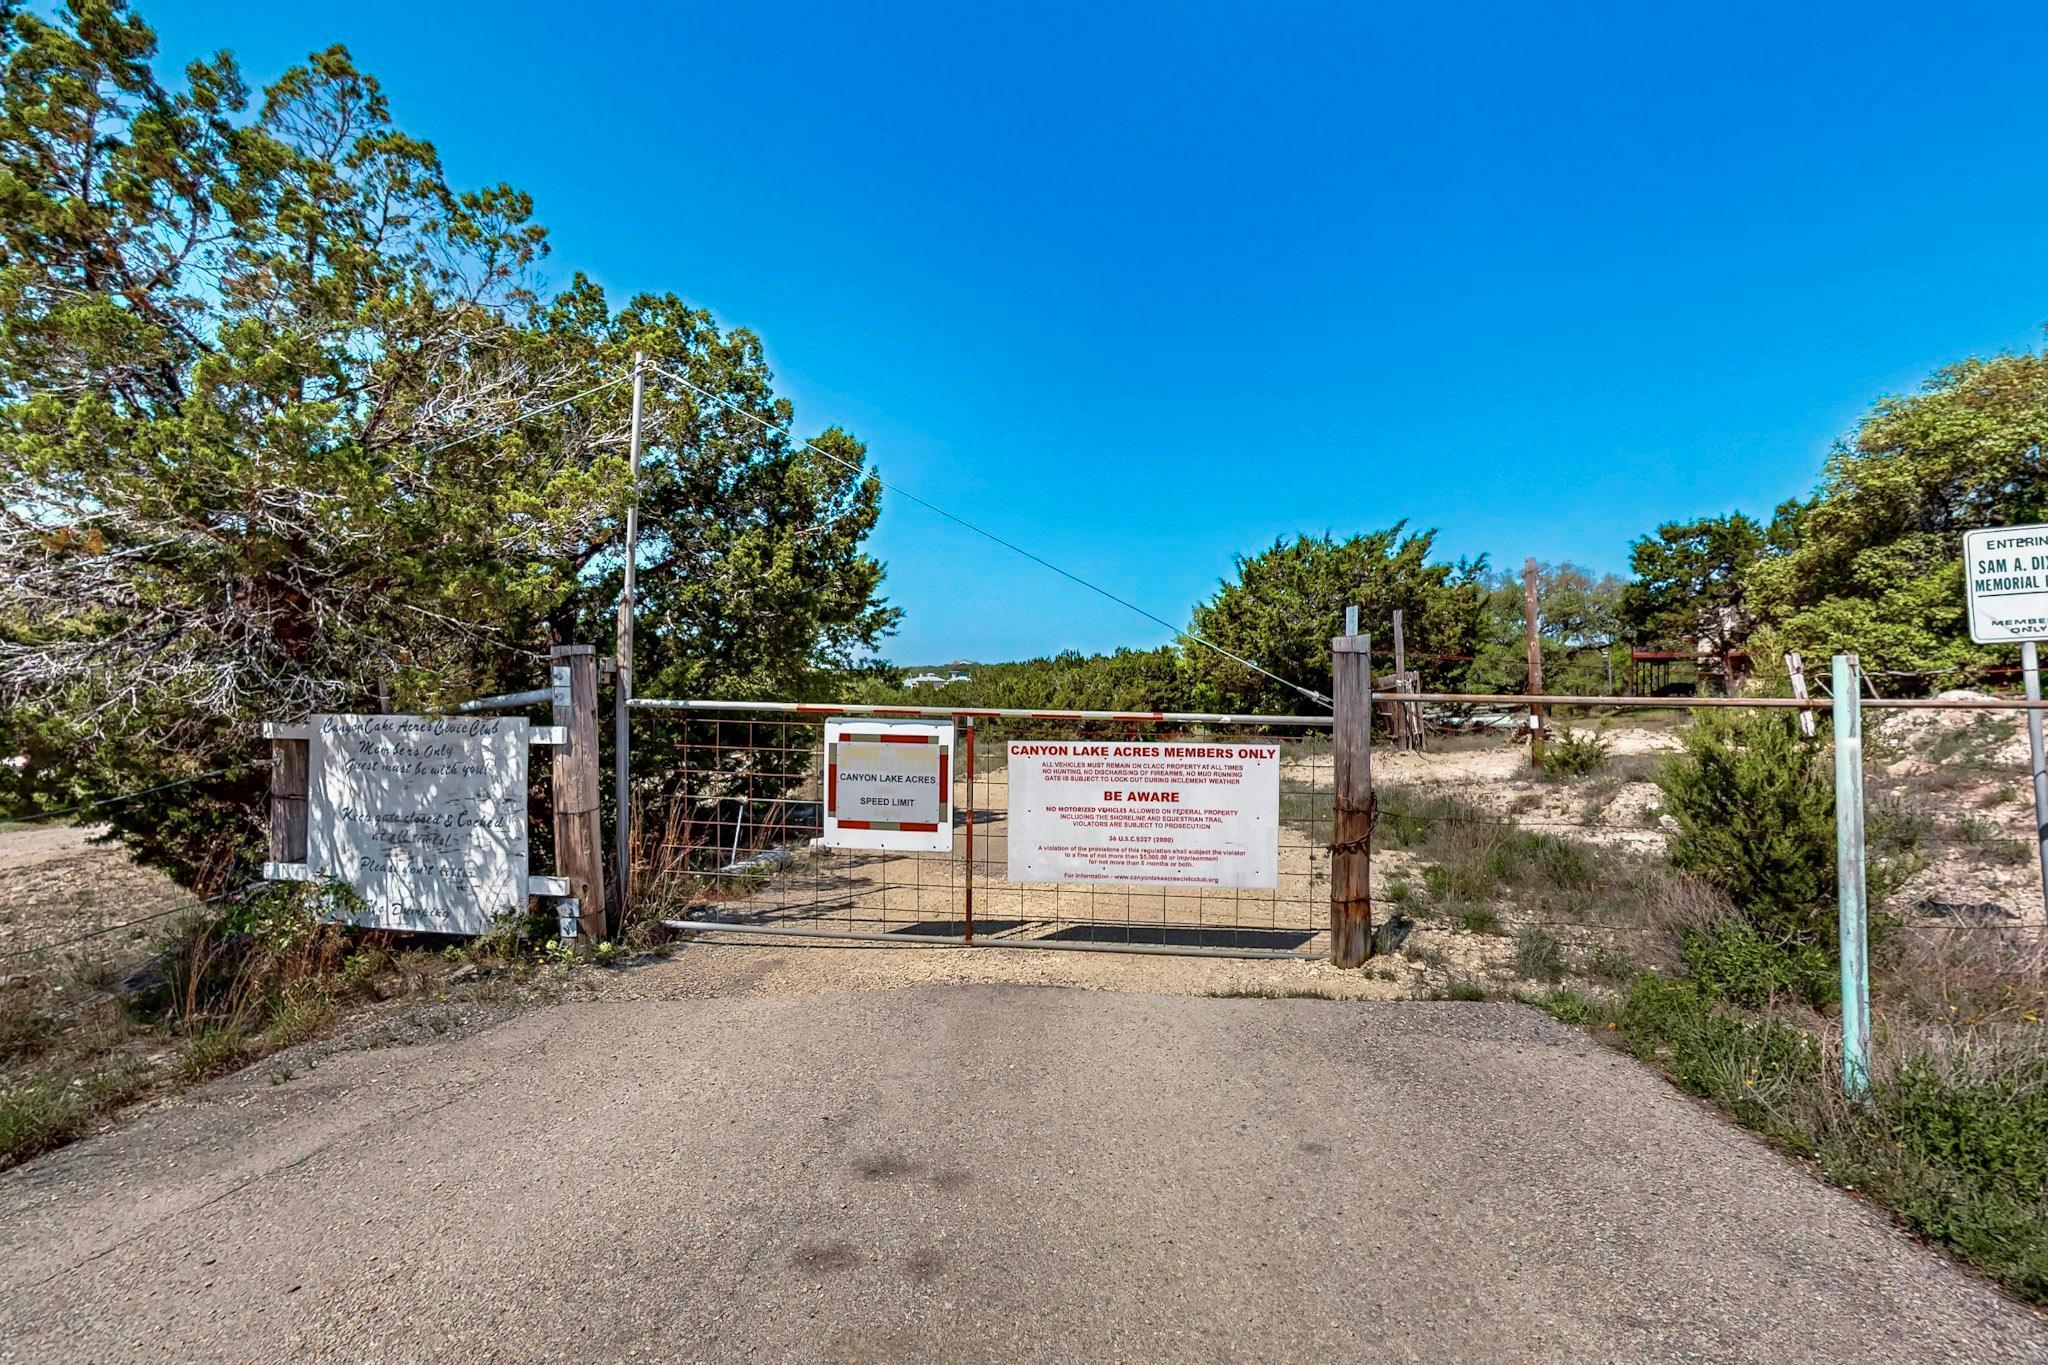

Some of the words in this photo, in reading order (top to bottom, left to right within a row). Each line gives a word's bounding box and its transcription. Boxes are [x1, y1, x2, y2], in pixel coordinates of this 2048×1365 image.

[1978, 559, 2007, 574] SAM
[2014, 558, 2027, 571] A.
[1975, 575, 2040, 592] MEMORIAL
[1991, 618, 2048, 626] MEMBE
[2010, 626, 2047, 634] ONLY
[323, 718, 364, 736] Canyon
[364, 718, 394, 734] Lake
[396, 719, 431, 733] Acres
[433, 719, 468, 735] Civic
[469, 719, 501, 737] Club
[358, 740, 419, 757] Members
[423, 744, 454, 759] Only
[1010, 745, 1068, 756] CANYON
[1073, 746, 1109, 756] LAKE
[1113, 747, 1160, 757] ACRES
[1164, 748, 1233, 759] MEMBERS
[1238, 749, 1276, 759] ONLY
[344, 758, 379, 775] Guest
[381, 762, 412, 774] must
[415, 763, 427, 775] be
[430, 762, 457, 775] with
[840, 773, 877, 782] CANYON
[879, 774, 904, 783] LAKE
[904, 775, 936, 784] ACRES
[859, 797, 890, 806] SPEED
[892, 798, 916, 807] LIMIT
[1104, 791, 1122, 802] BE
[1127, 792, 1180, 803] AWARE
